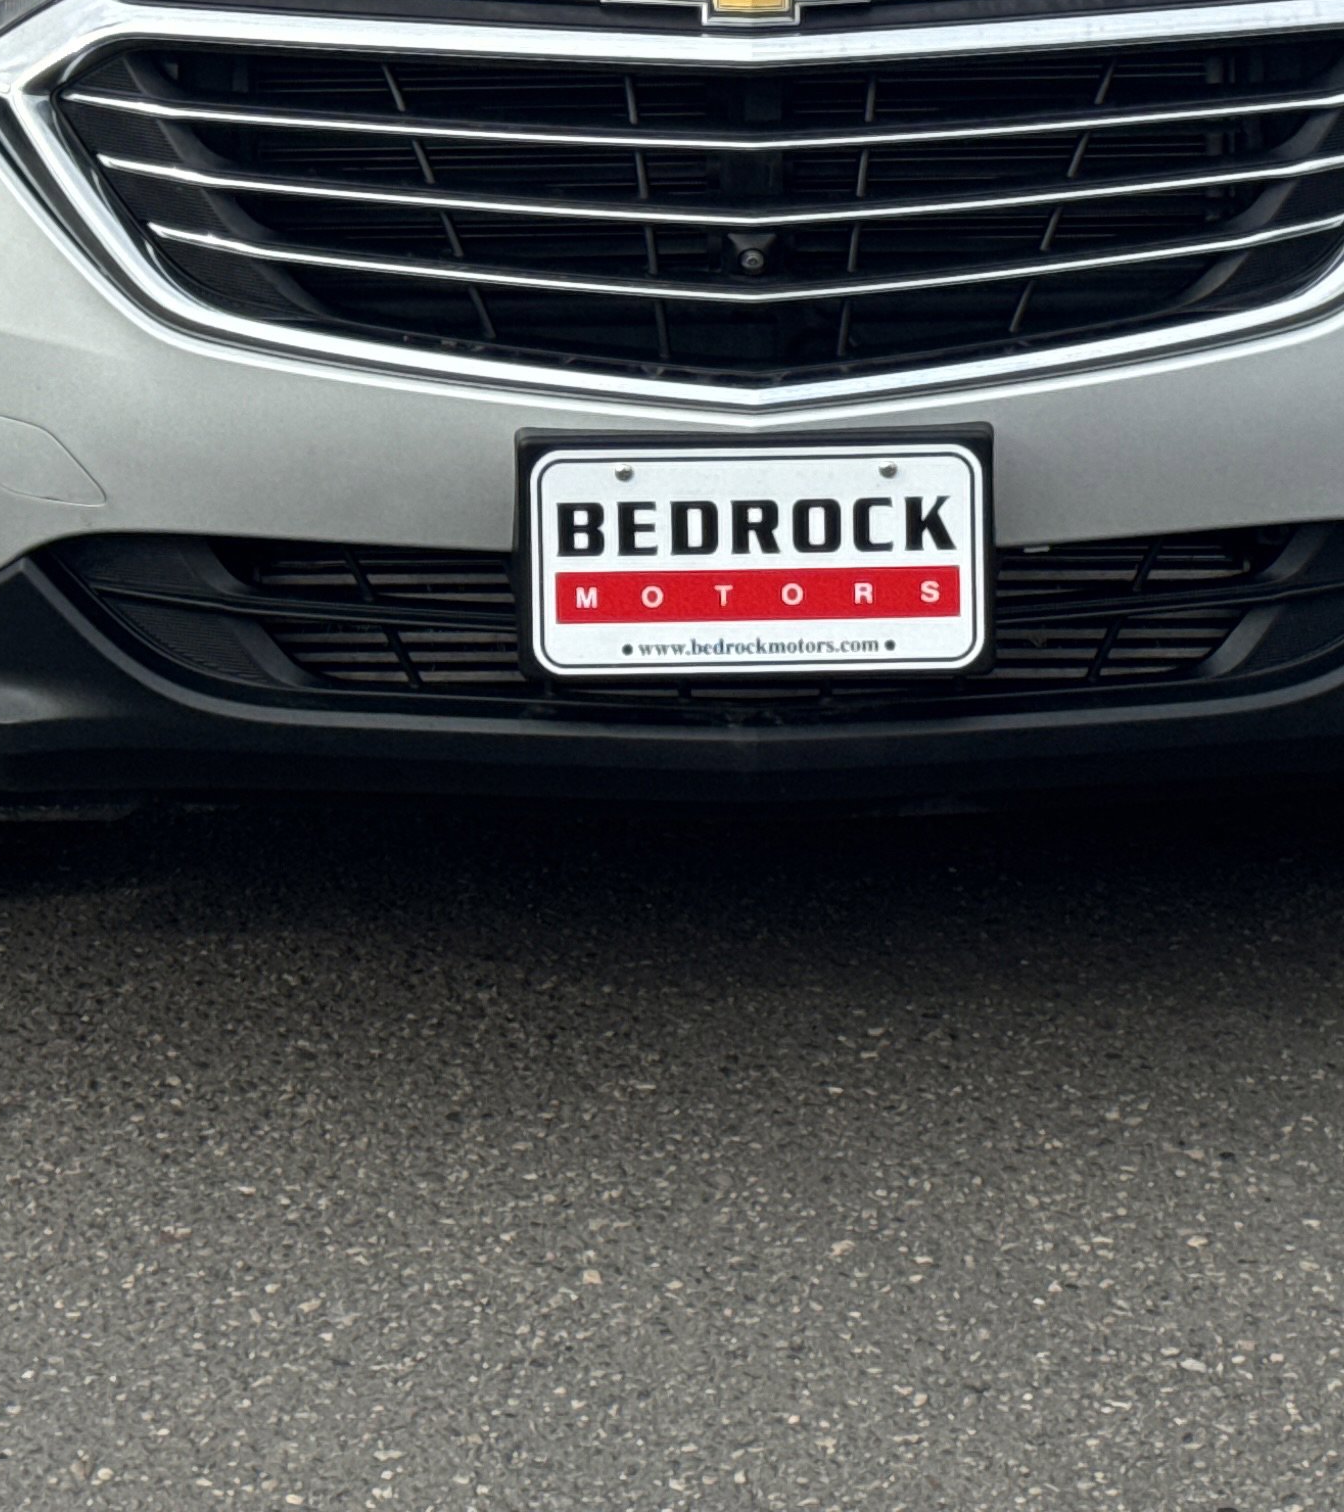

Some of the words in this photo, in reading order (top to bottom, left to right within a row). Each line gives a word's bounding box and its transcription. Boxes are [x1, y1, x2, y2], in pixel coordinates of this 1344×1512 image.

[556, 496, 956, 556] BEDROCK
[575, 581, 940, 609] MOTORS
[638, 637, 880, 656] www.bedrockmotors.com
